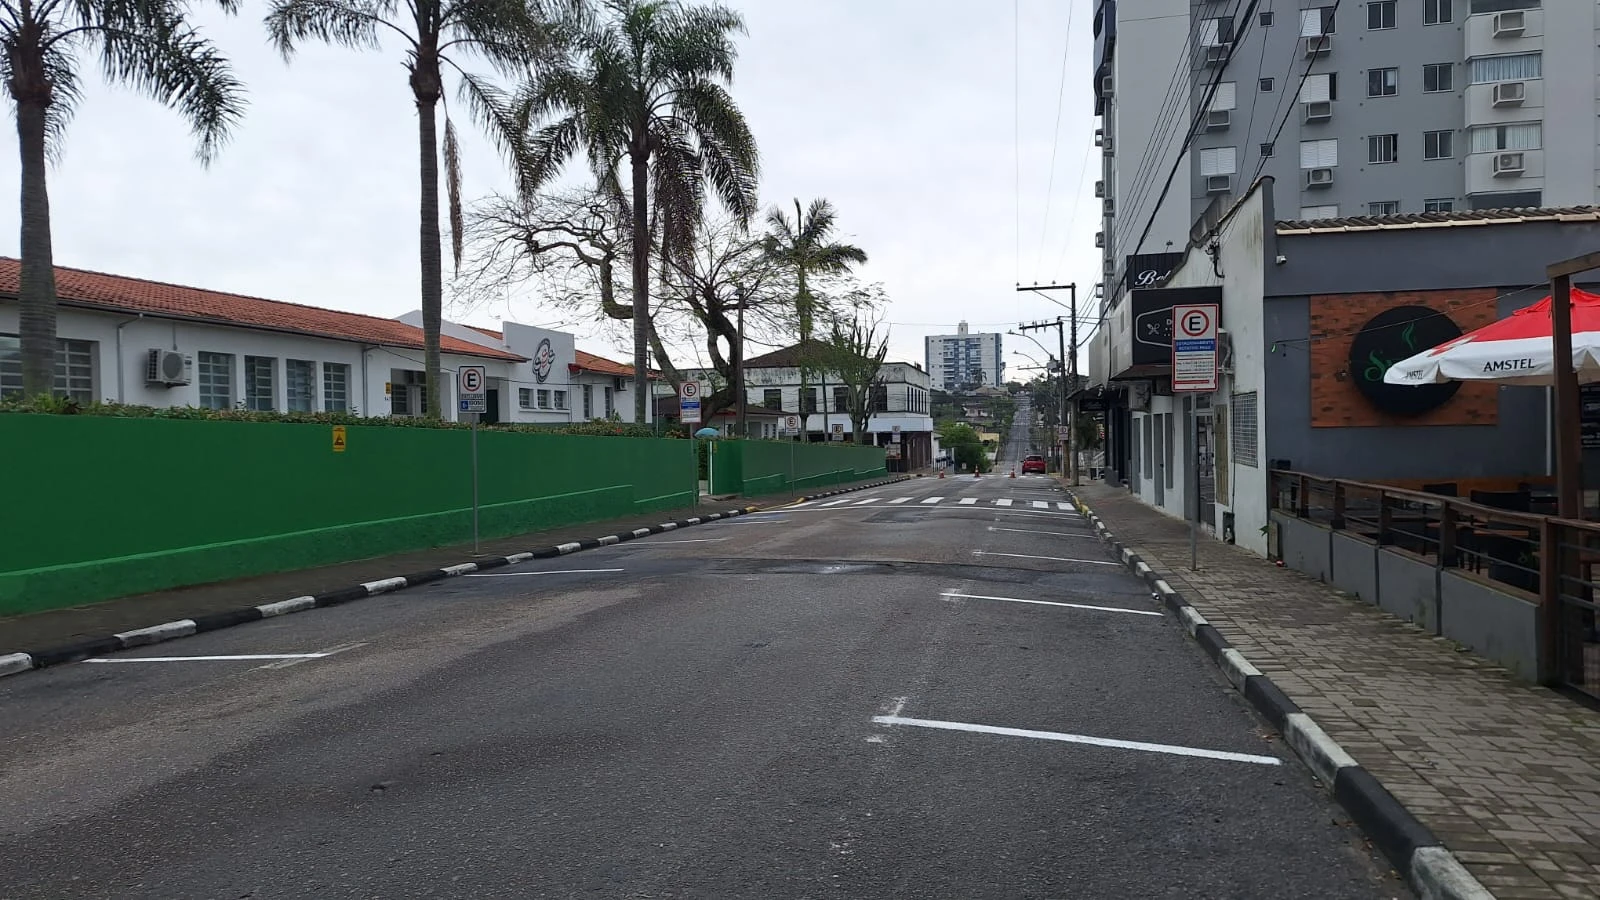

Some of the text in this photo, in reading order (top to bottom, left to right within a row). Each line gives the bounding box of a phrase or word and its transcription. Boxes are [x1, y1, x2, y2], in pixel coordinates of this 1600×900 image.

[1189, 316, 1201, 331] E
[1483, 358, 1536, 372] AMSTEL
[467, 373, 477, 387] E
